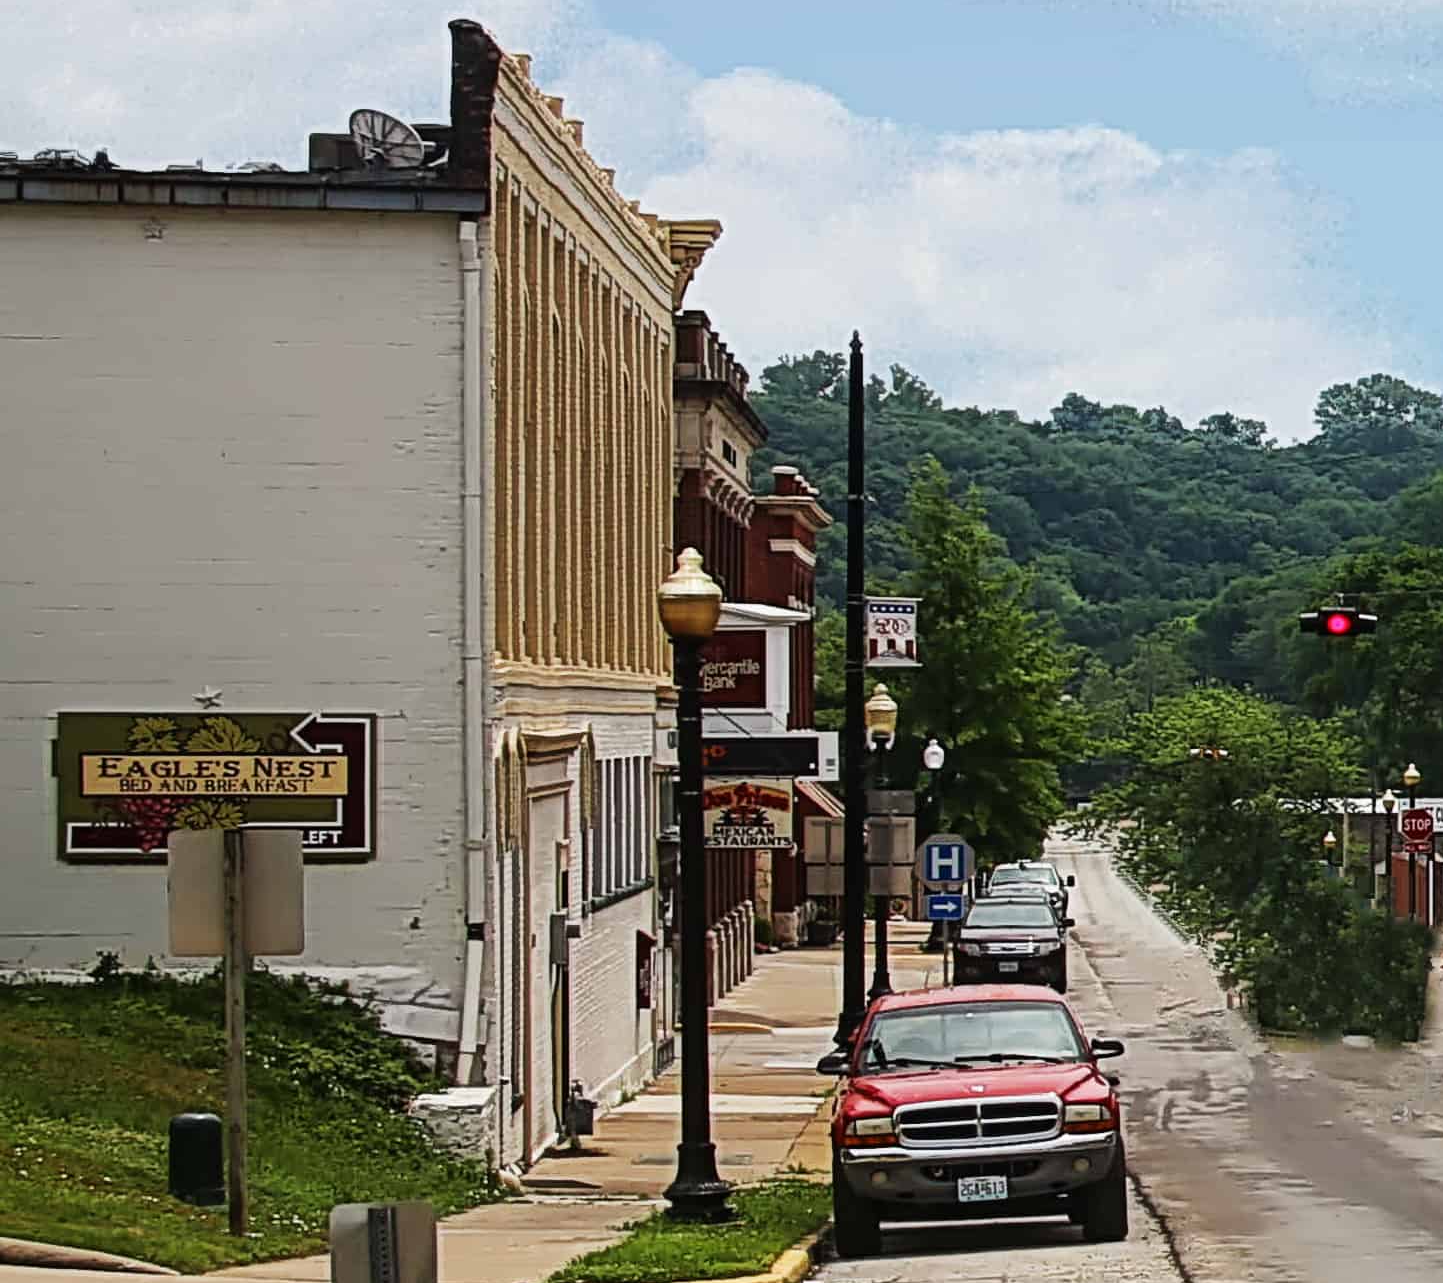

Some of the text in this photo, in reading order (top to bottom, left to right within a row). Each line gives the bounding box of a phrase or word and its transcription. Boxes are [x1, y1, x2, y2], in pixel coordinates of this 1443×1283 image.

[704, 676, 736, 692] Bank
[97, 757, 337, 779] EAGLE'S NEST
[119, 779, 314, 793] BED AND BREAKFAST
[712, 824, 775, 837] MEXICAN
[1403, 819, 1432, 831] STOP
[302, 830, 343, 845] EFT
[704, 837, 793, 846] ESTAURANTS
[931, 846, 960, 880] H
